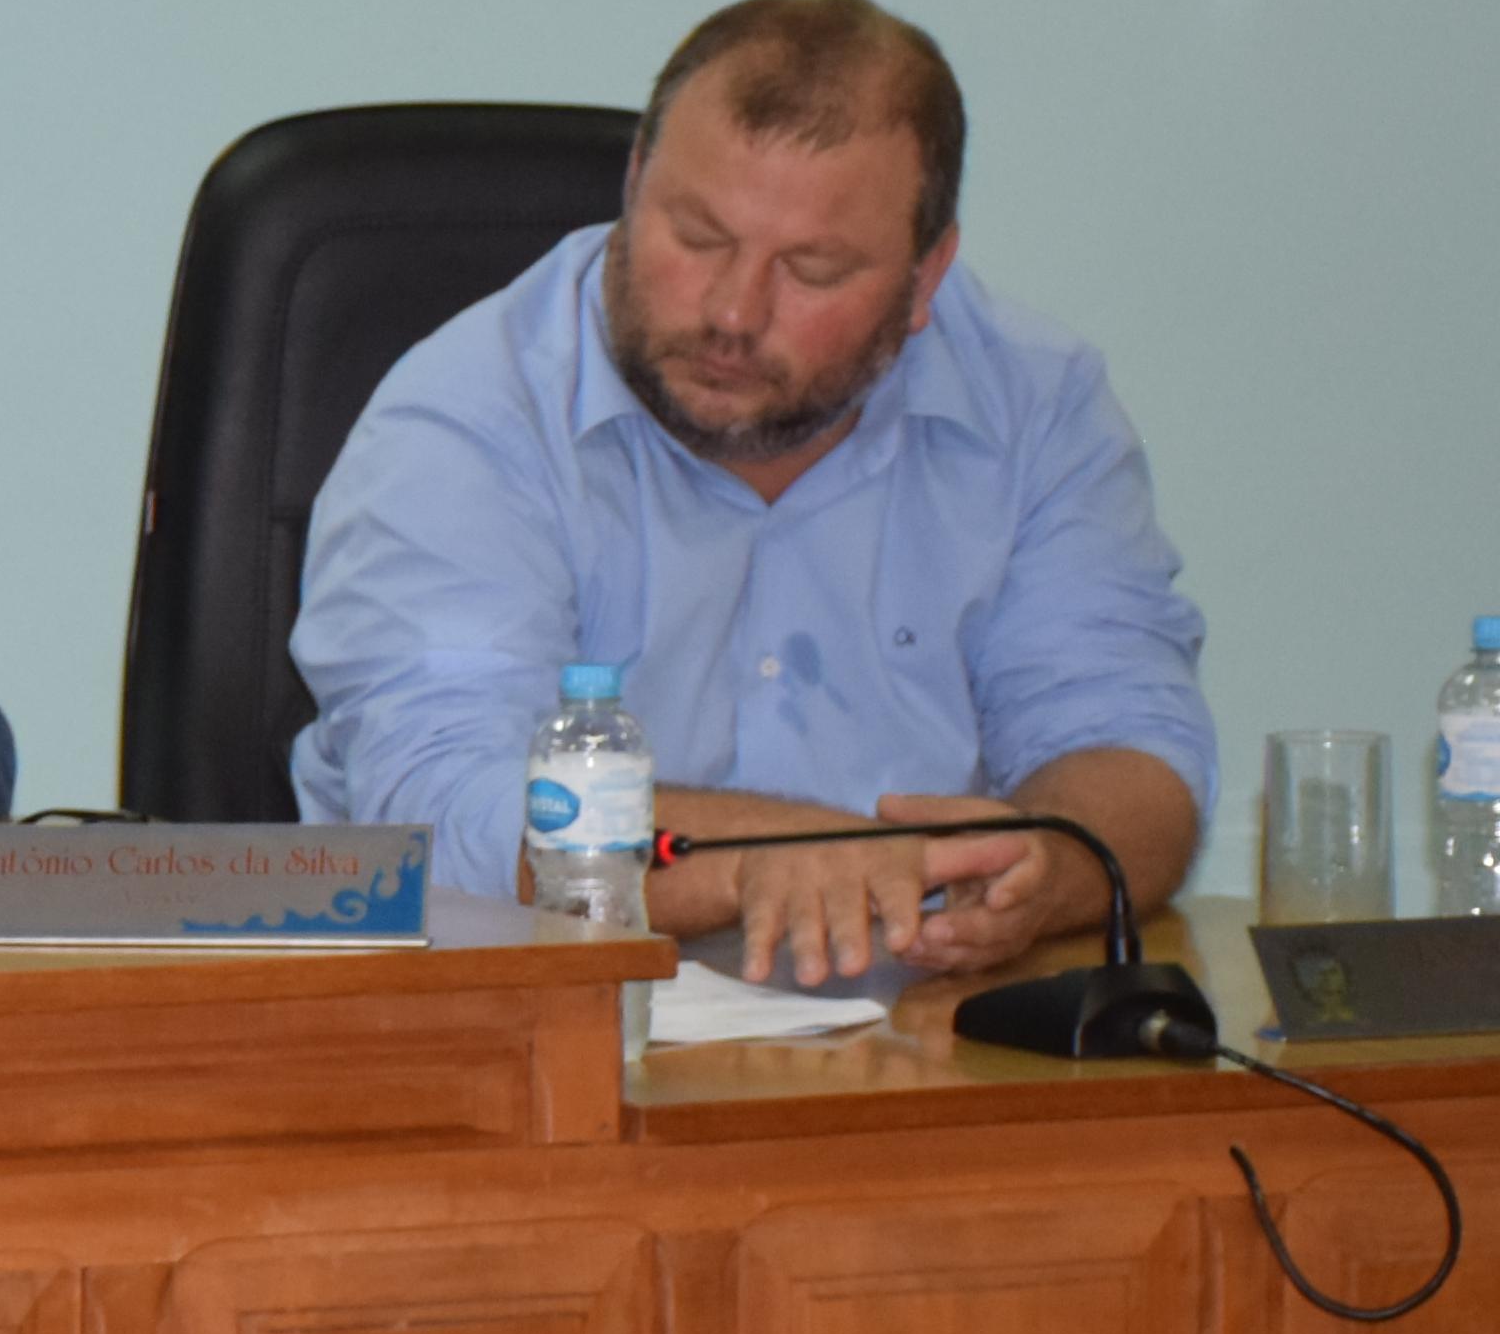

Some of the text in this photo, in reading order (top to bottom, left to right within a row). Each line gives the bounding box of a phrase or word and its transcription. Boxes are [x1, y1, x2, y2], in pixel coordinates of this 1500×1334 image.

[108, 845, 216, 875] Carlos
[228, 845, 269, 875] da
[284, 845, 359, 876] Silva
